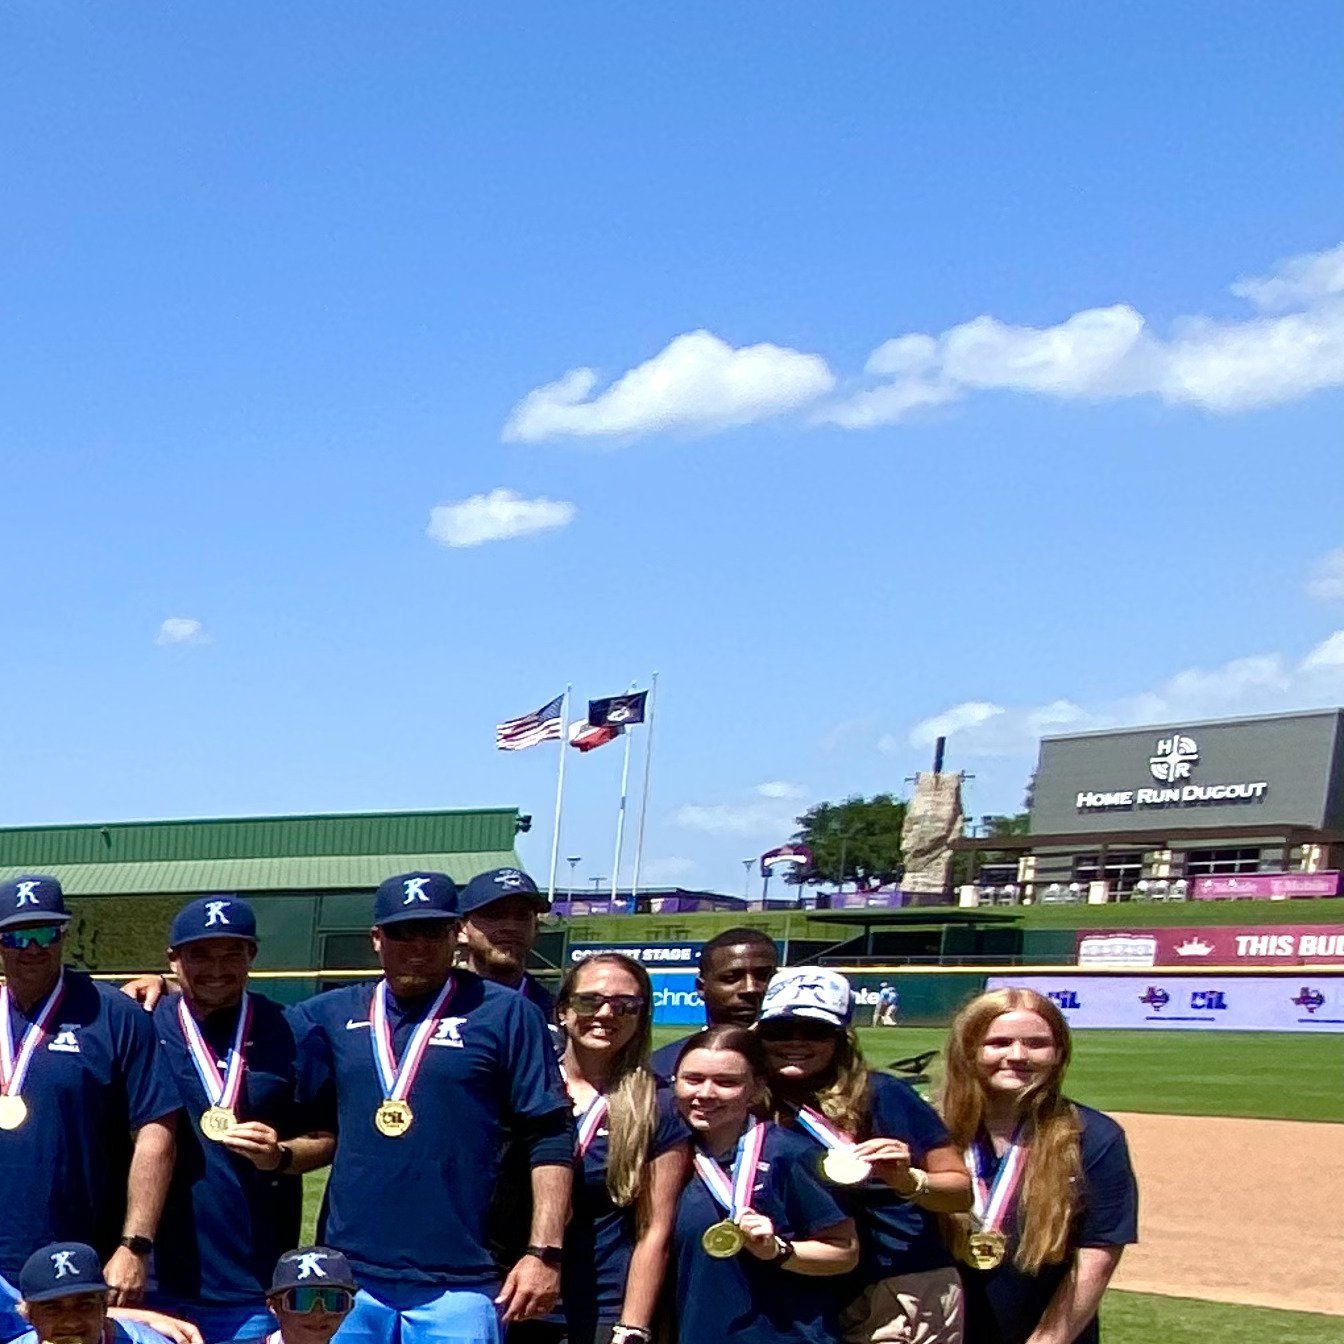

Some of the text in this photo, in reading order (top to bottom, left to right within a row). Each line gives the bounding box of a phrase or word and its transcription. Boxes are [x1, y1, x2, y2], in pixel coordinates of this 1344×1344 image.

[1157, 740, 1170, 755] H
[1176, 763, 1192, 778] R
[1077, 782, 1267, 808] HOME RUN DUGOUT
[1235, 936, 1296, 956] THIS
[642, 949, 691, 960] STAGE
